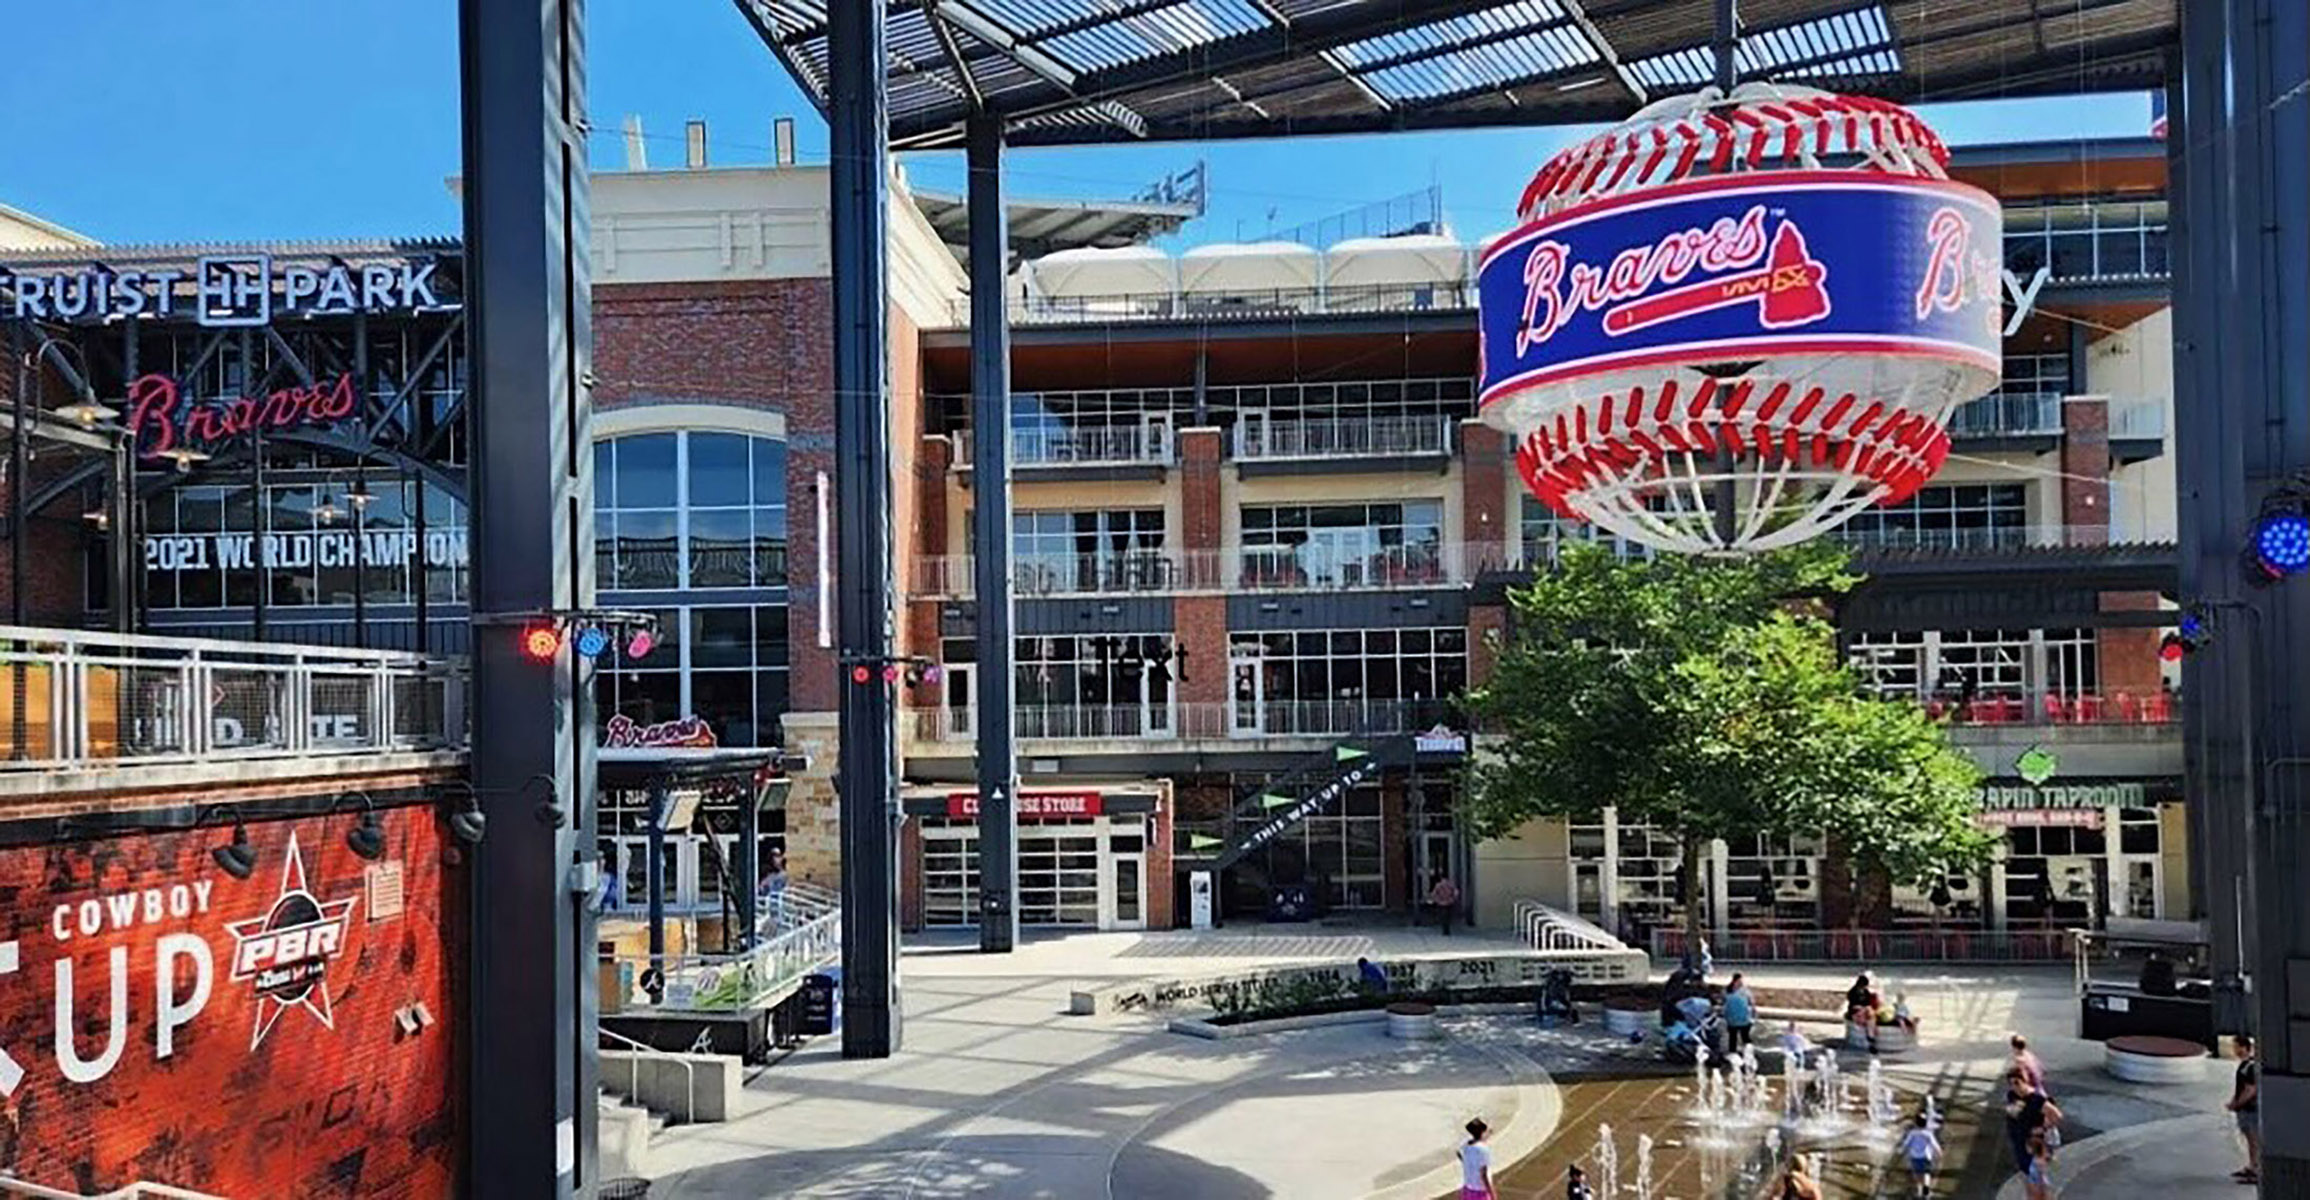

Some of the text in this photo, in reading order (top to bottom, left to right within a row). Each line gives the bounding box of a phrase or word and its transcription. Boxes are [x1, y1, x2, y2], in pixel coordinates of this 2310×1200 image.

[285, 264, 438, 309] PARK
[1516, 205, 1767, 359] Braves
[128, 371, 355, 458] Braves
[146, 537, 209, 570] 2021
[215, 535, 311, 569] WORLD
[52, 879, 214, 940] COWBOY
[238, 922, 342, 973] PBR
[54, 932, 214, 1083] UP
